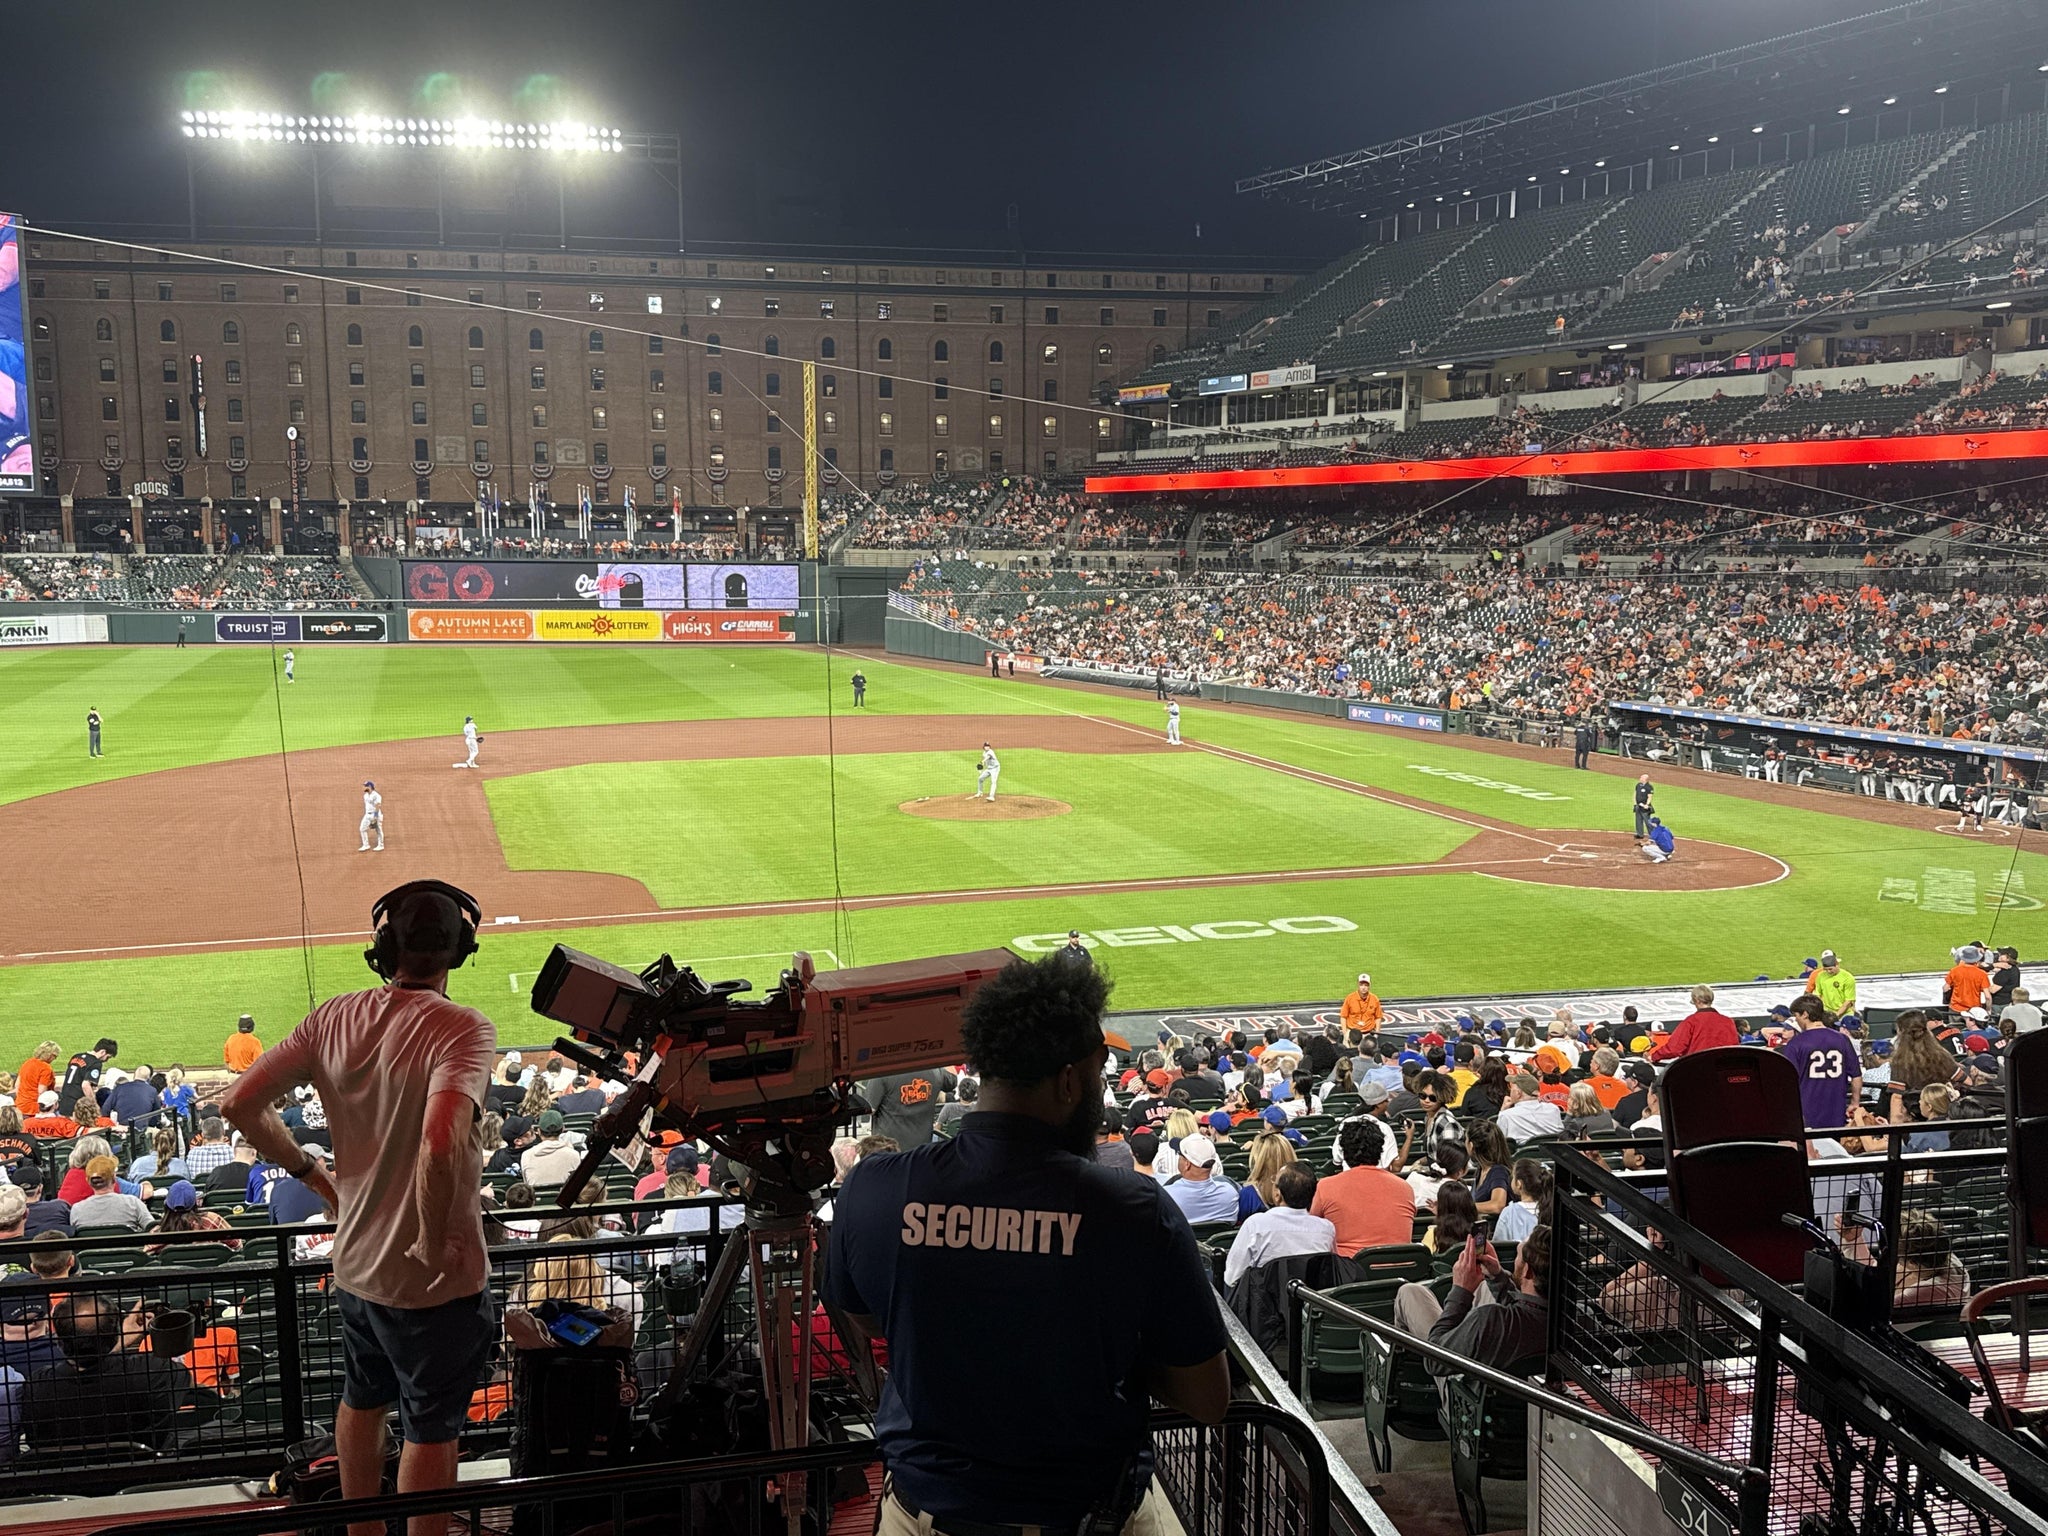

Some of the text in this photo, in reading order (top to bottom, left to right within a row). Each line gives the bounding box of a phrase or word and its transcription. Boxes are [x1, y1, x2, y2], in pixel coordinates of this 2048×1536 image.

[409, 564, 494, 603] GO
[228, 623, 268, 633] TRUIST
[437, 618, 525, 627] AUTUMN LAKE
[546, 621, 591, 630] MARYLAND
[612, 622, 649, 630] LOTTERY
[673, 622, 711, 636] HIGH'S
[1012, 915, 1359, 953] GEICO
[1810, 1051, 1842, 1078] 23
[901, 1202, 1082, 1256] SECURITY
[1681, 1491, 1709, 1536] 54
